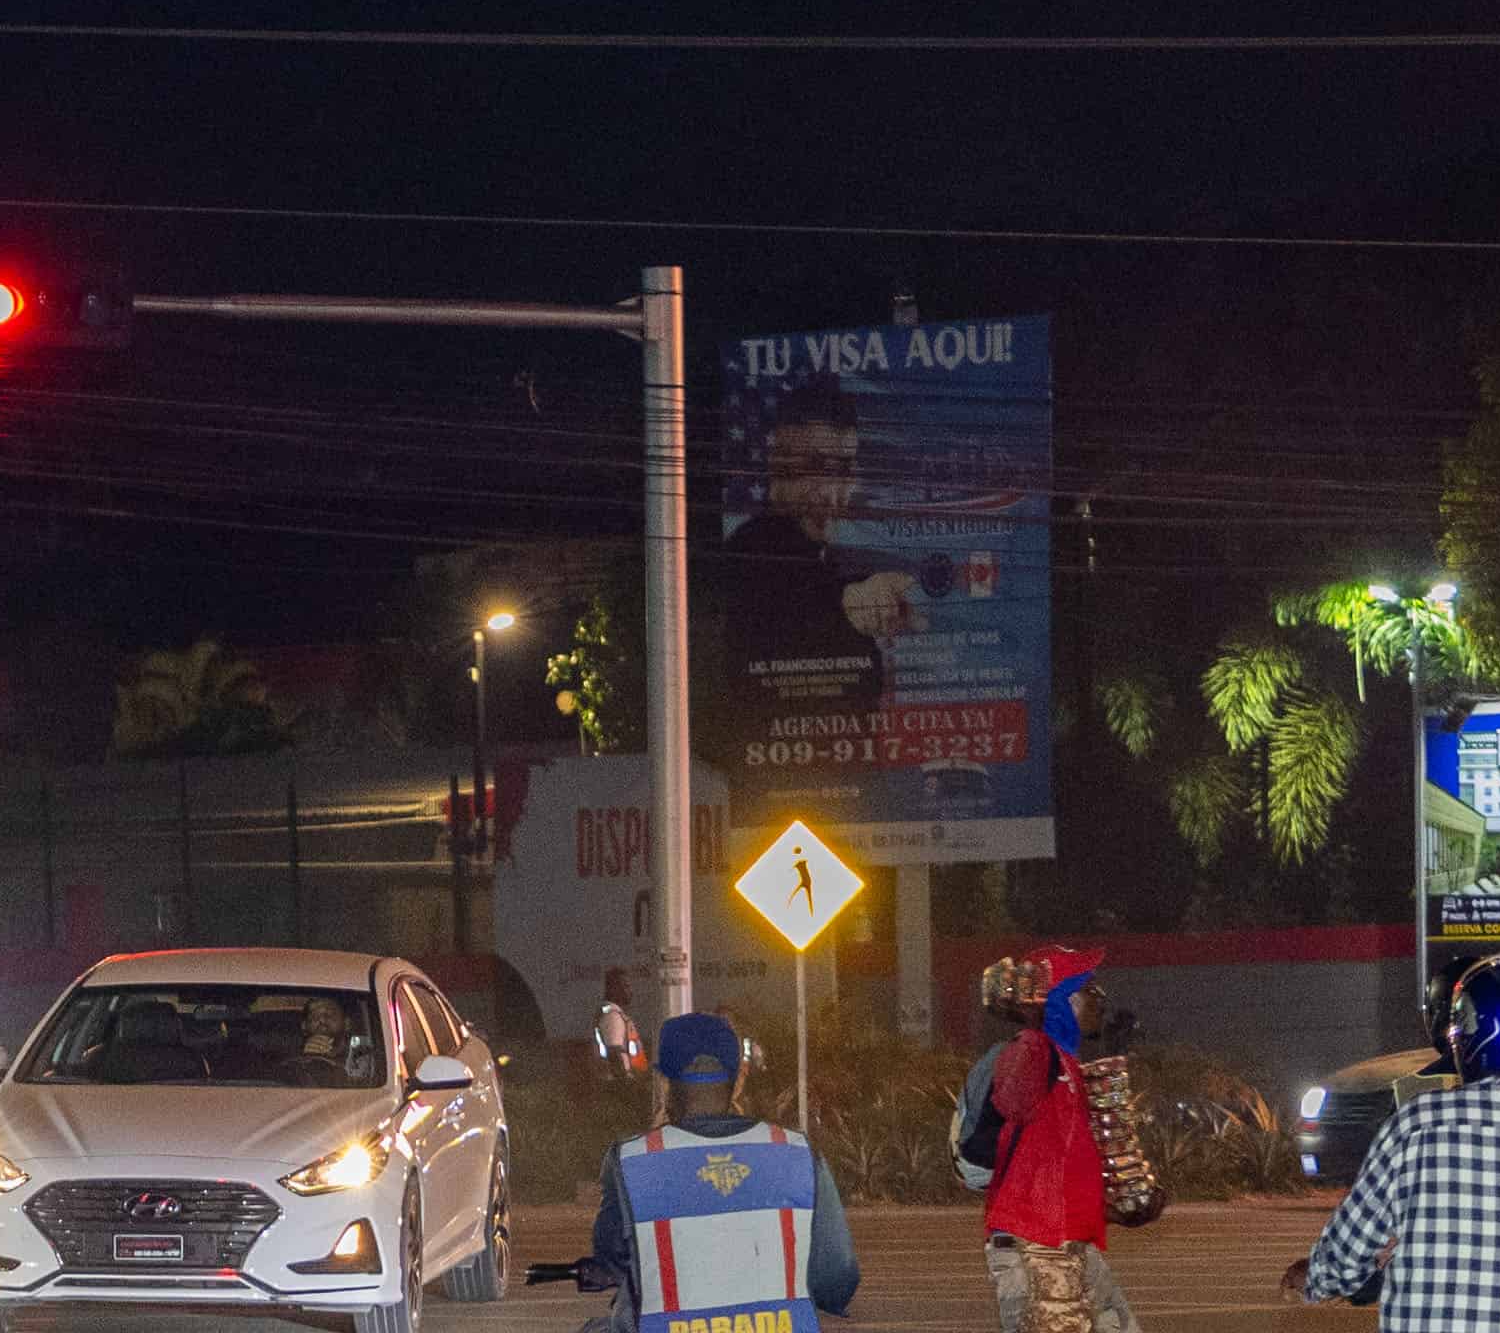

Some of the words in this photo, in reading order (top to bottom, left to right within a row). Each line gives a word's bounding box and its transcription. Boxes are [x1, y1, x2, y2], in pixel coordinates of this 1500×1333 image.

[741, 336, 791, 376] TU
[804, 329, 889, 372] VISA
[769, 714, 861, 738] AGENDA
[867, 713, 893, 733] TU
[903, 710, 954, 732] CITA
